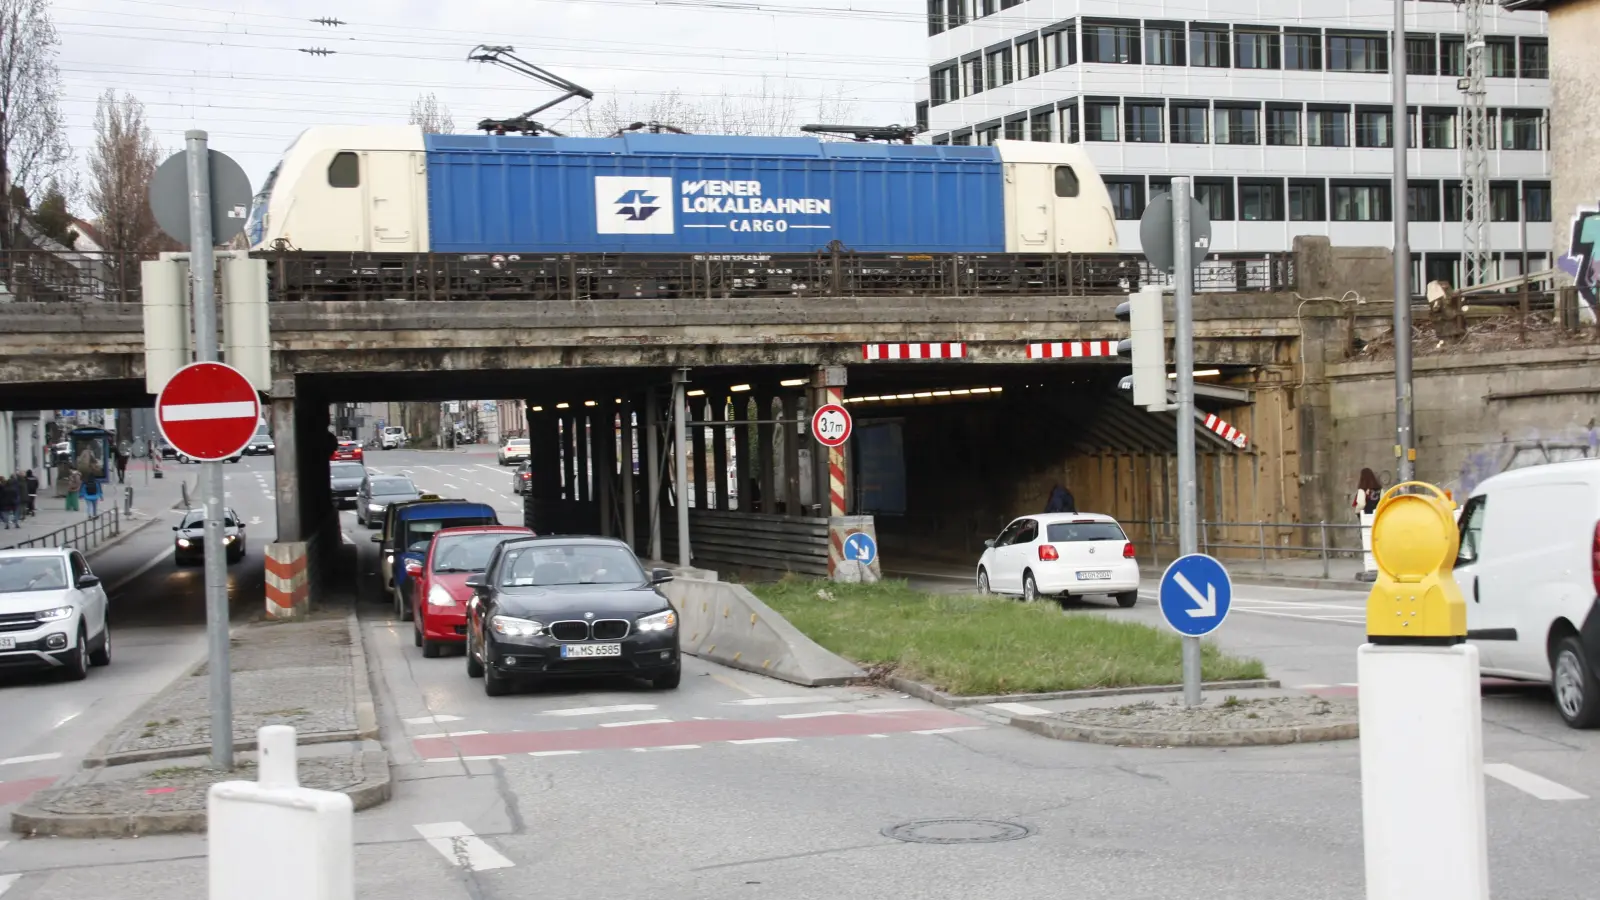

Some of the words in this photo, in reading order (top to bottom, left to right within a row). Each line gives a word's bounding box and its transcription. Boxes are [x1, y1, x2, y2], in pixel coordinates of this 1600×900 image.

[682, 180, 762, 196] WIENER
[682, 197, 831, 214] LOKALBAHNEN
[729, 219, 788, 232] CARGO
[568, 646, 575, 656] M
[581, 645, 594, 656] MS
[596, 644, 620, 655] 6585
